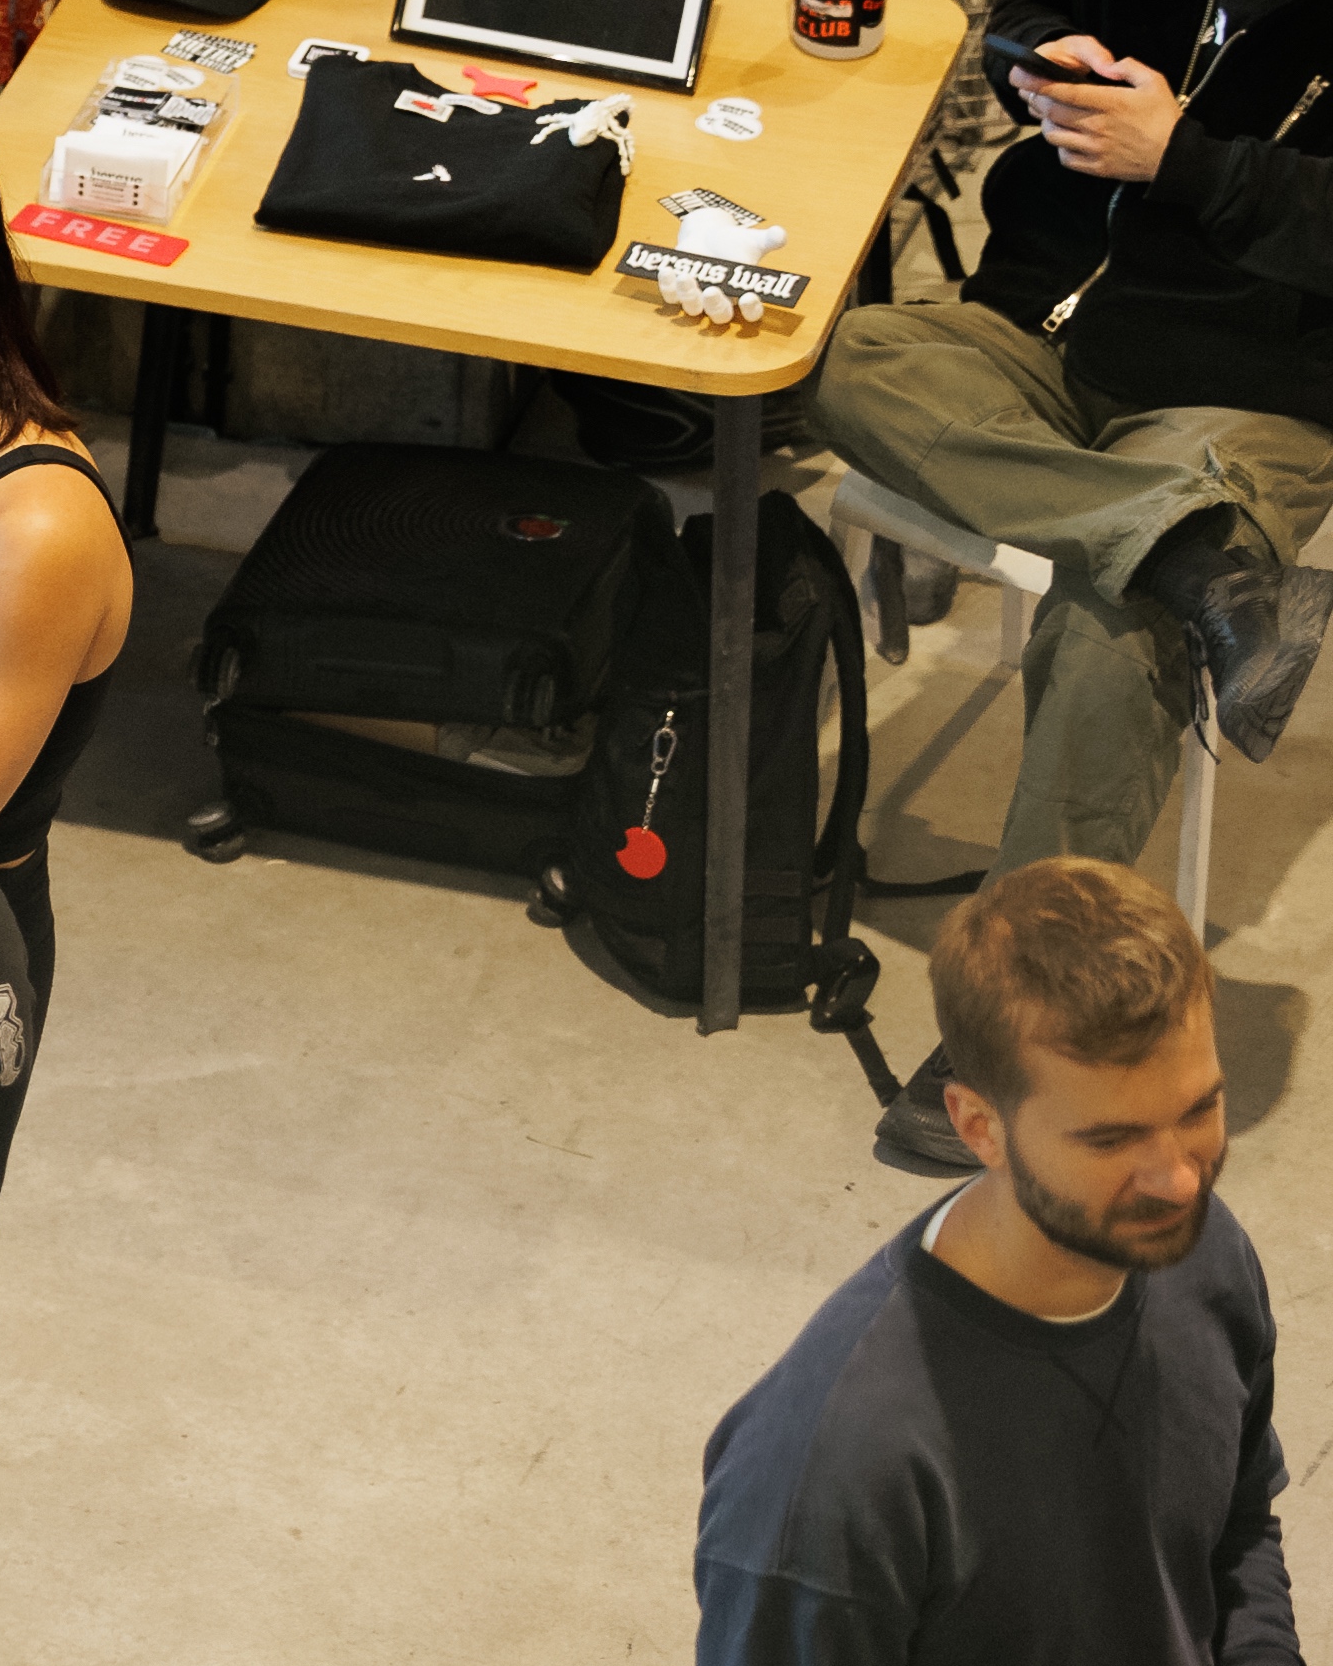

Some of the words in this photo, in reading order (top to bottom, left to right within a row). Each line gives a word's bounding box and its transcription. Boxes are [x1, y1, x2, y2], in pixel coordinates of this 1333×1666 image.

[797, 15, 851, 38] CLUB
[30, 212, 160, 254] FREE
[626, 244, 729, 284] versus
[729, 266, 800, 299] wall
